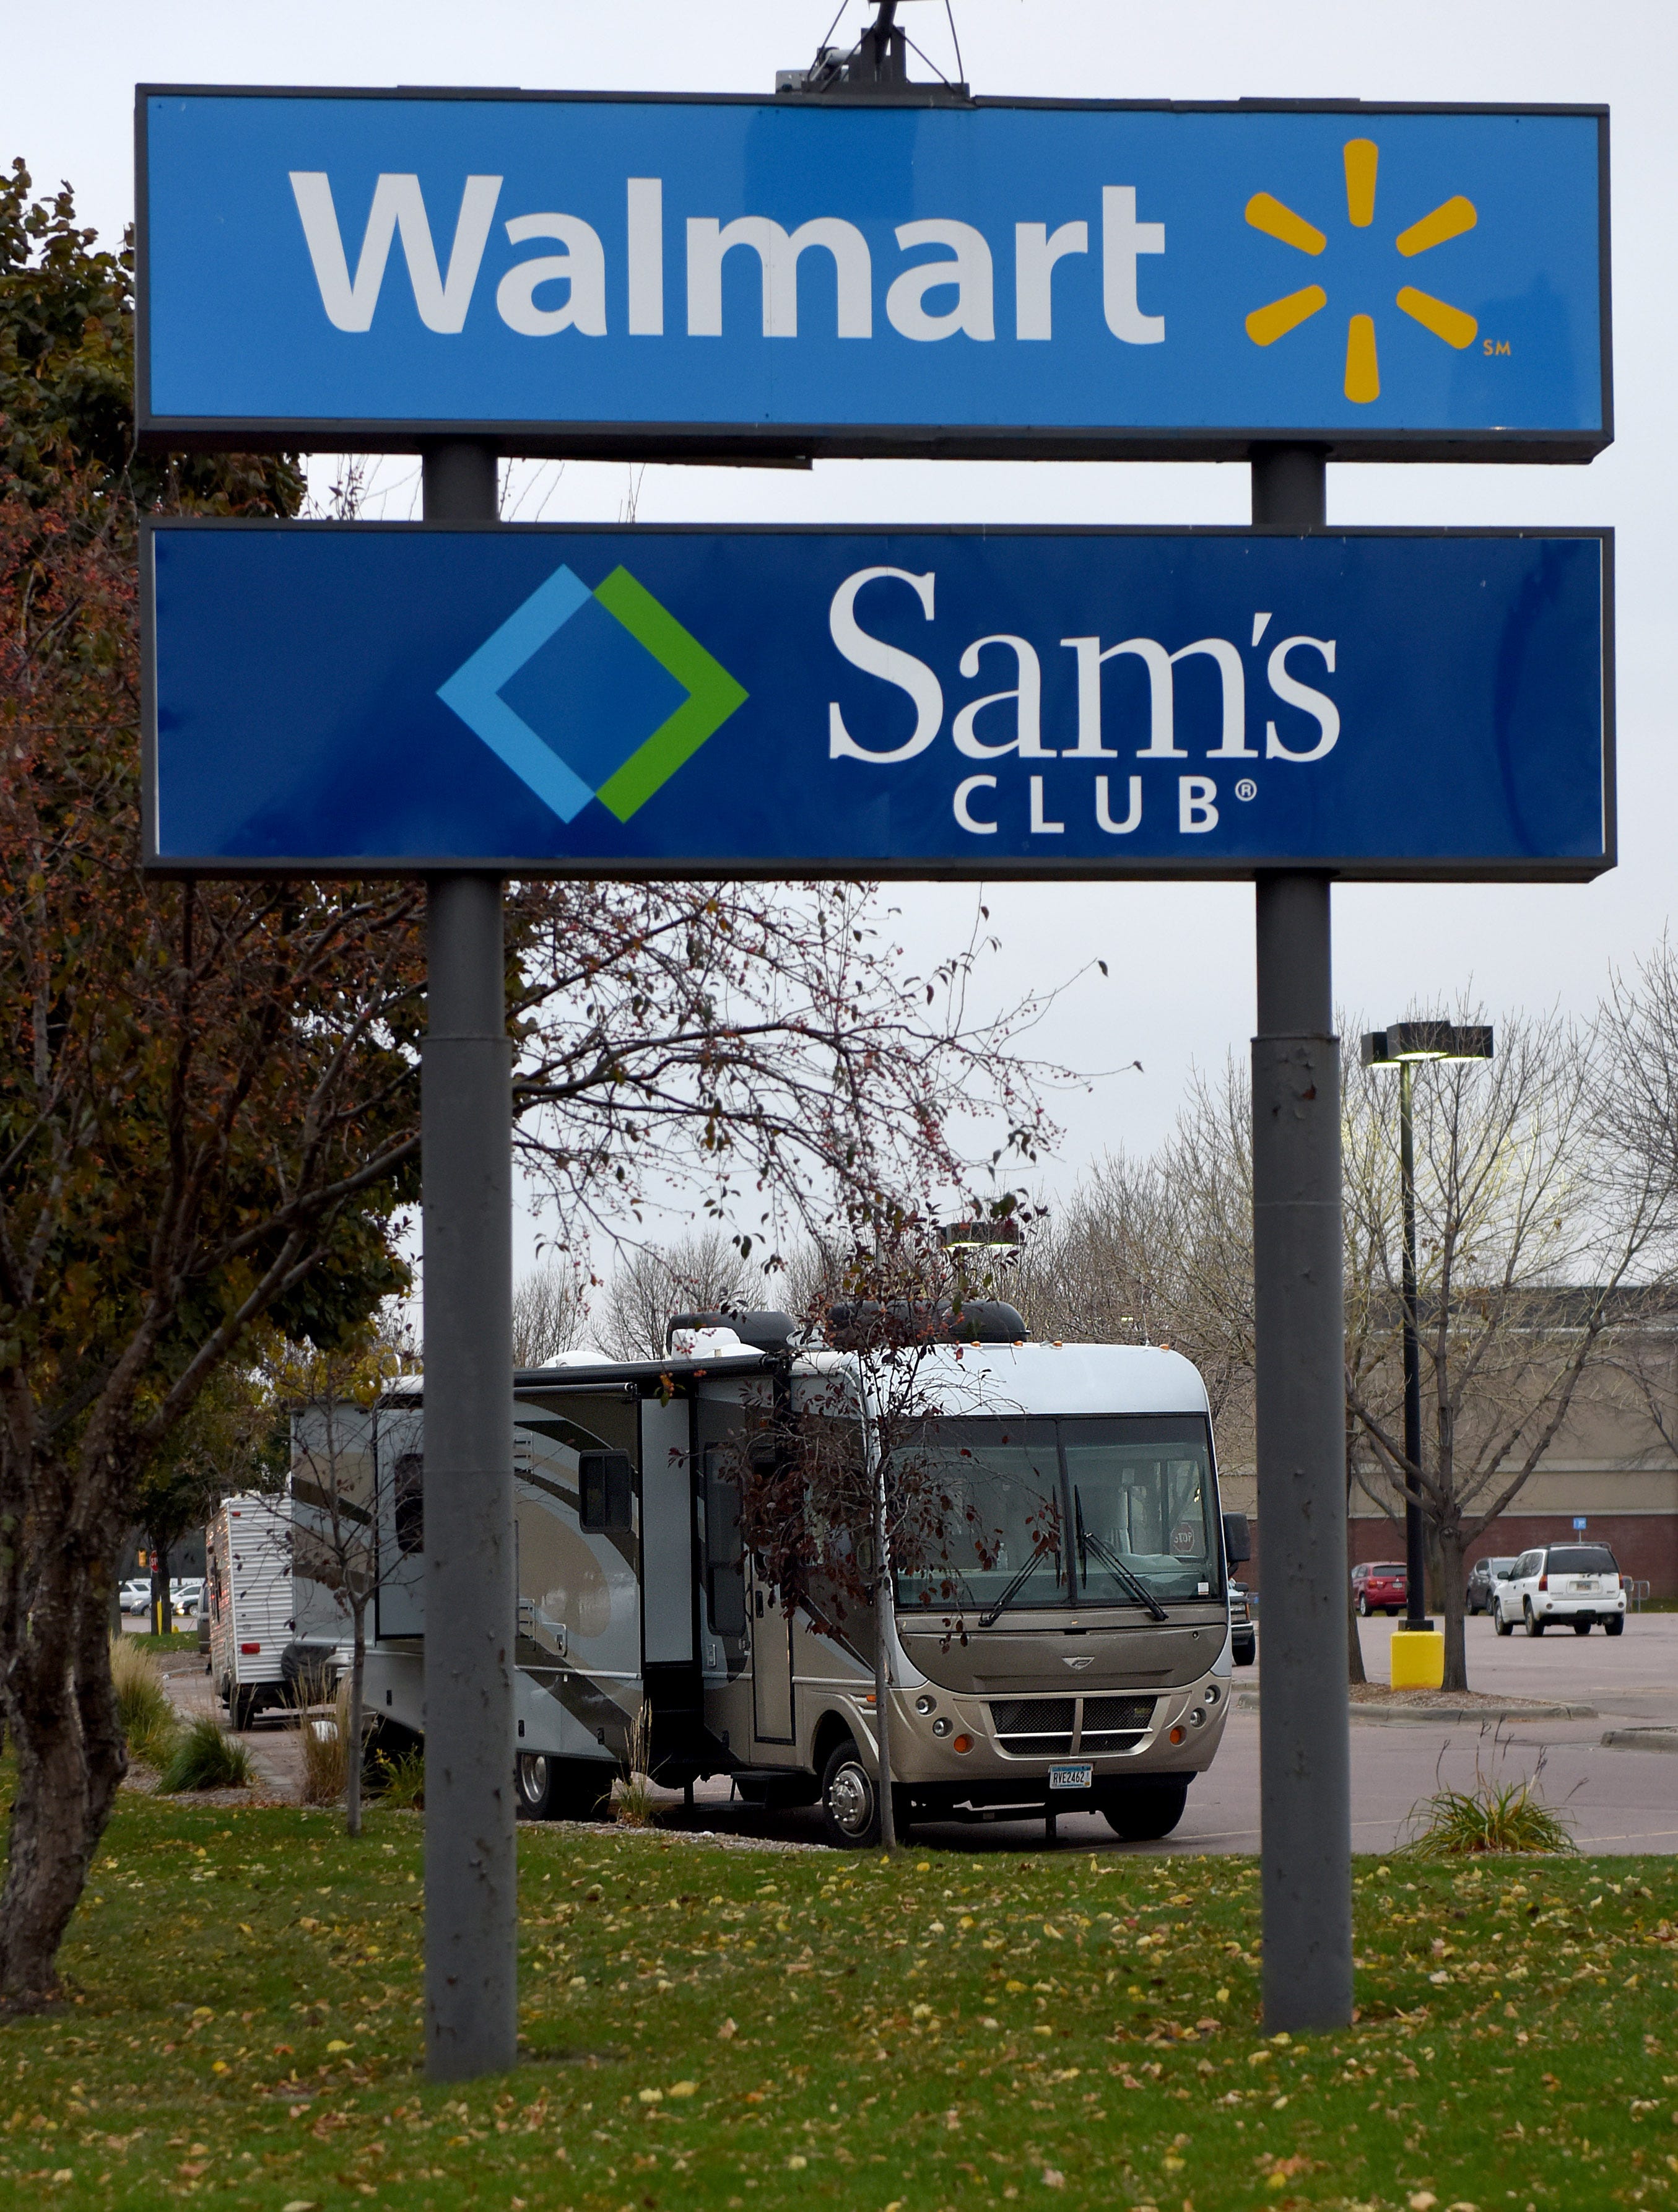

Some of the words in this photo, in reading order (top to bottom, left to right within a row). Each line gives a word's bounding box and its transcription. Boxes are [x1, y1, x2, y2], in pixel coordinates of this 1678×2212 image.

[288, 170, 1167, 345] Walmart
[1483, 339, 1511, 355] SM
[829, 566, 1341, 764] Sam's
[1174, 1531, 1193, 1543] STOP
[1053, 1771, 1084, 1783] RVE2462
